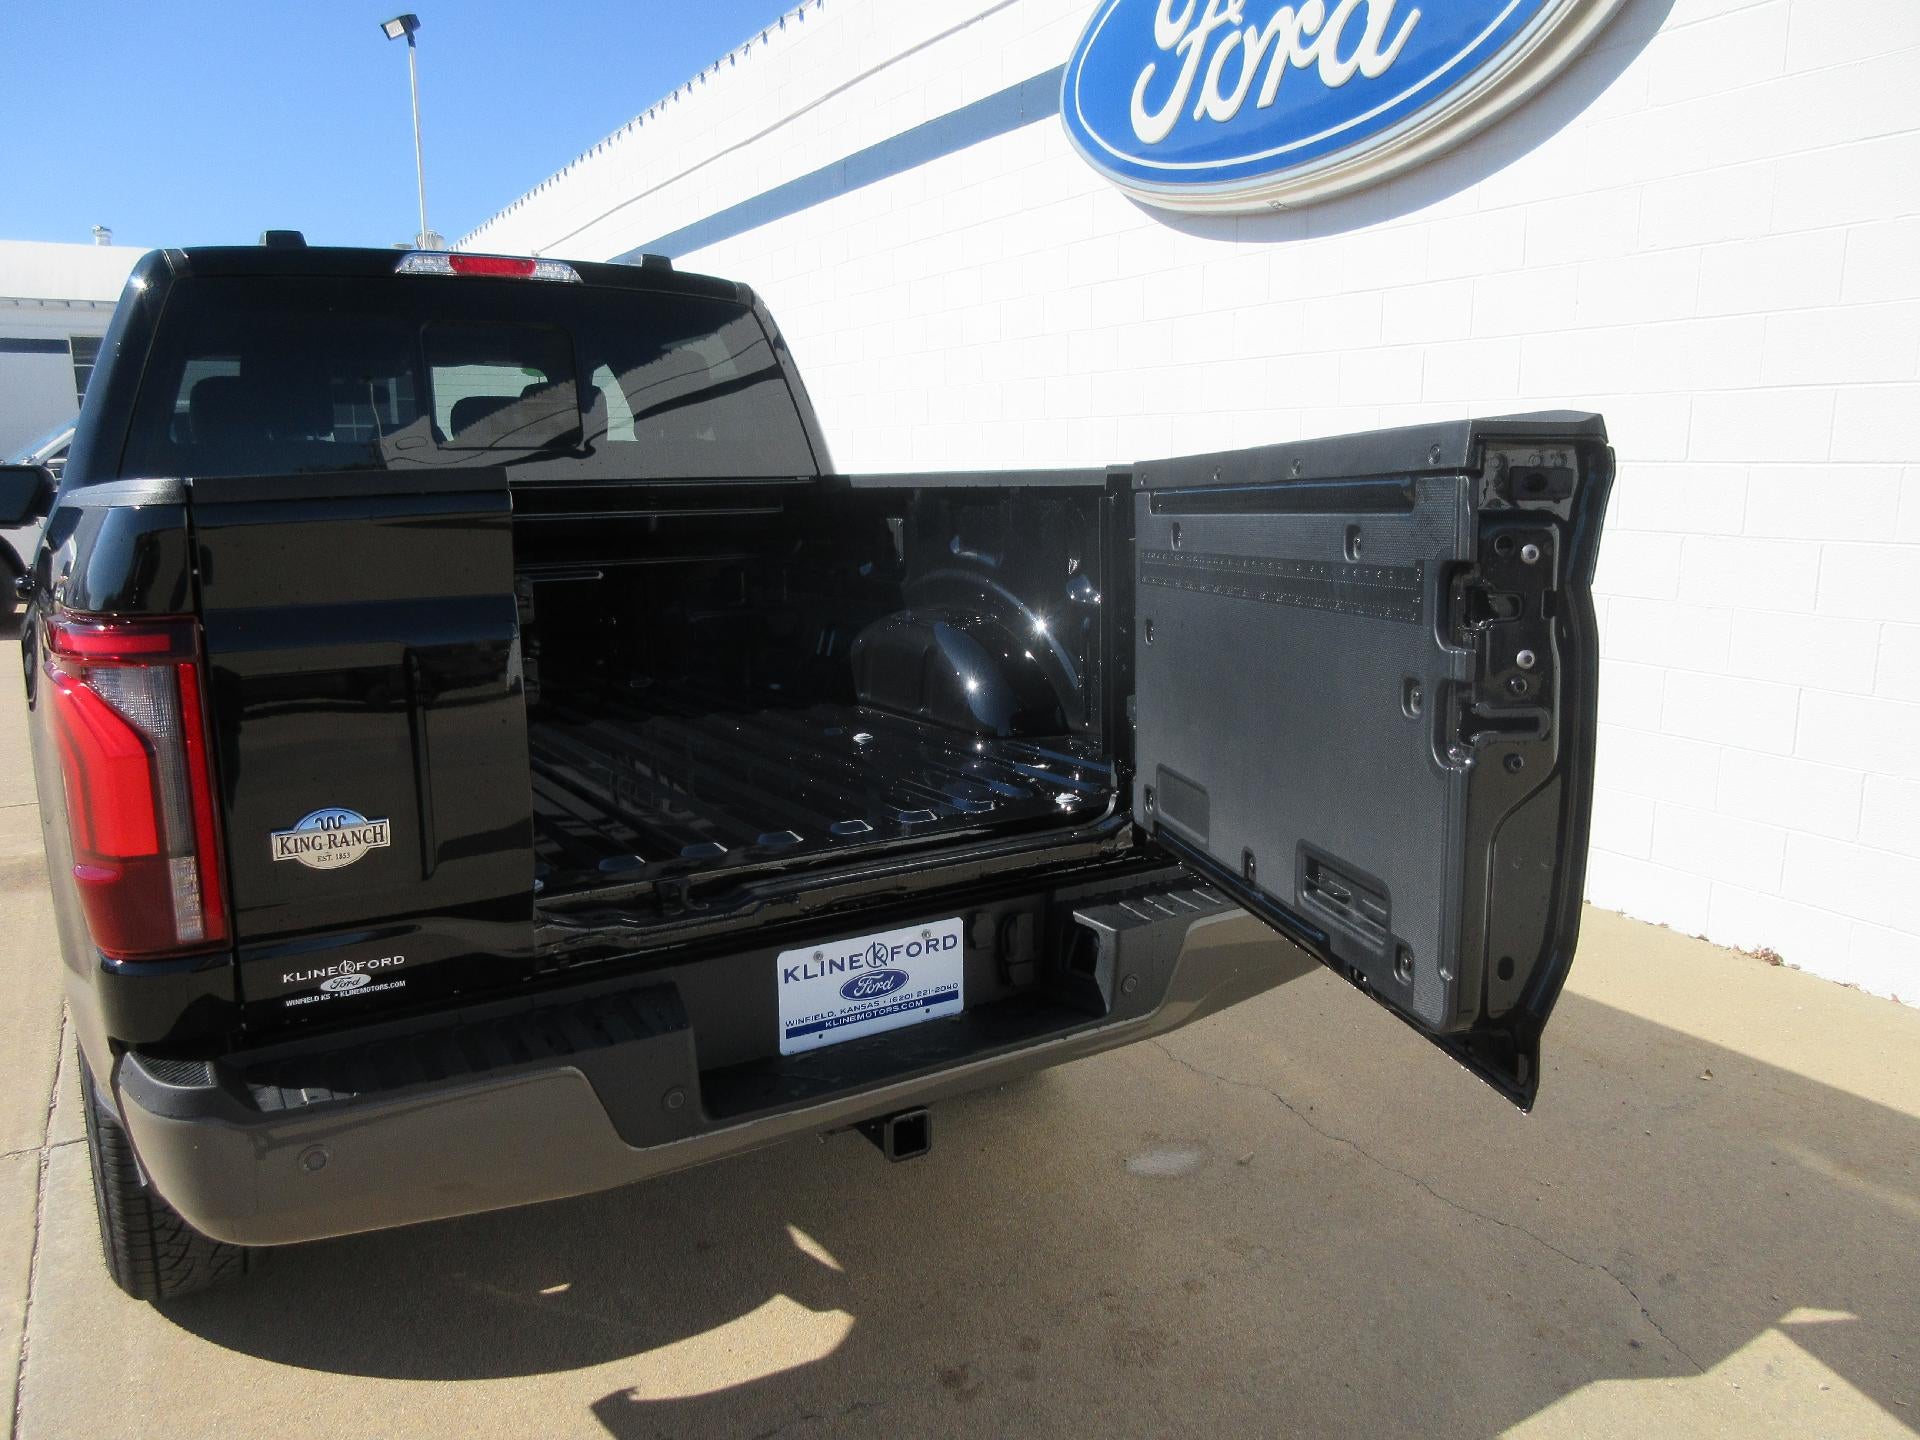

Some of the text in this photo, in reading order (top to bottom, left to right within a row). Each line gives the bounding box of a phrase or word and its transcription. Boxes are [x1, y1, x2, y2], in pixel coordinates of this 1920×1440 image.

[280, 824, 384, 855] KING RANCH
[283, 966, 338, 983] KLINE
[356, 955, 405, 971] FORD
[784, 953, 863, 984] KLINE
[890, 933, 958, 962] FORD
[285, 980, 406, 1007] WINFIELD KS KLINEMOTORS.COM
[329, 976, 361, 990] Ford
[853, 973, 894, 997] Ford
[785, 1010, 837, 1028] WINFIELD,
[840, 1000, 880, 1015] KANSAS
[916, 983, 958, 998] 221-2040
[825, 999, 923, 1028] KLINEMOTORS.COM
